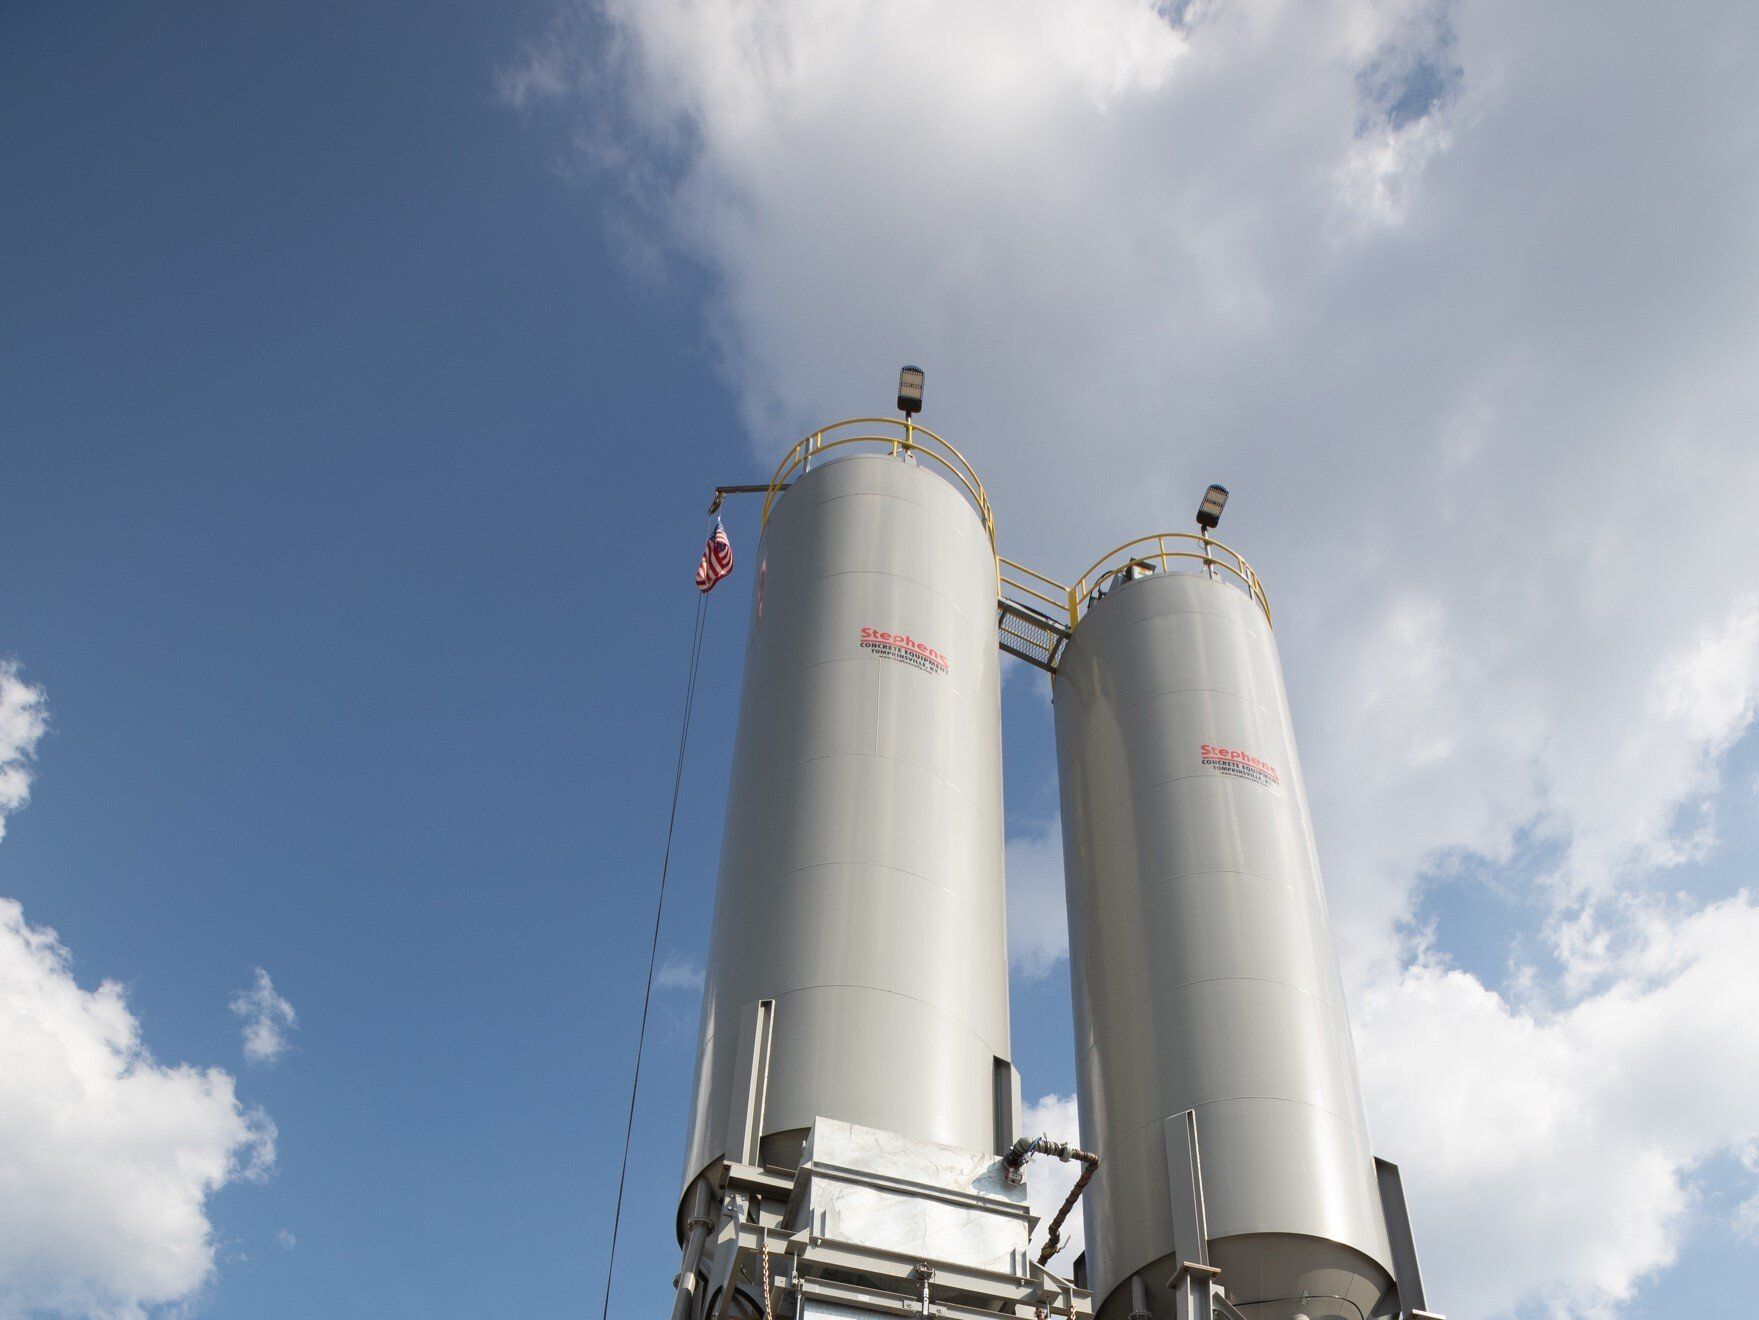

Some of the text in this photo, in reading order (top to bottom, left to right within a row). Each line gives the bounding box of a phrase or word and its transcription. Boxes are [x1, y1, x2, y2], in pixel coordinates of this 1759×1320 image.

[860, 627, 949, 668] Stephens
[860, 642, 949, 675] CONCRETE EQUIPMENT
[1200, 744, 1280, 780] Stephens
[1201, 759, 1280, 786] CONCRETE EQUIPMENT
